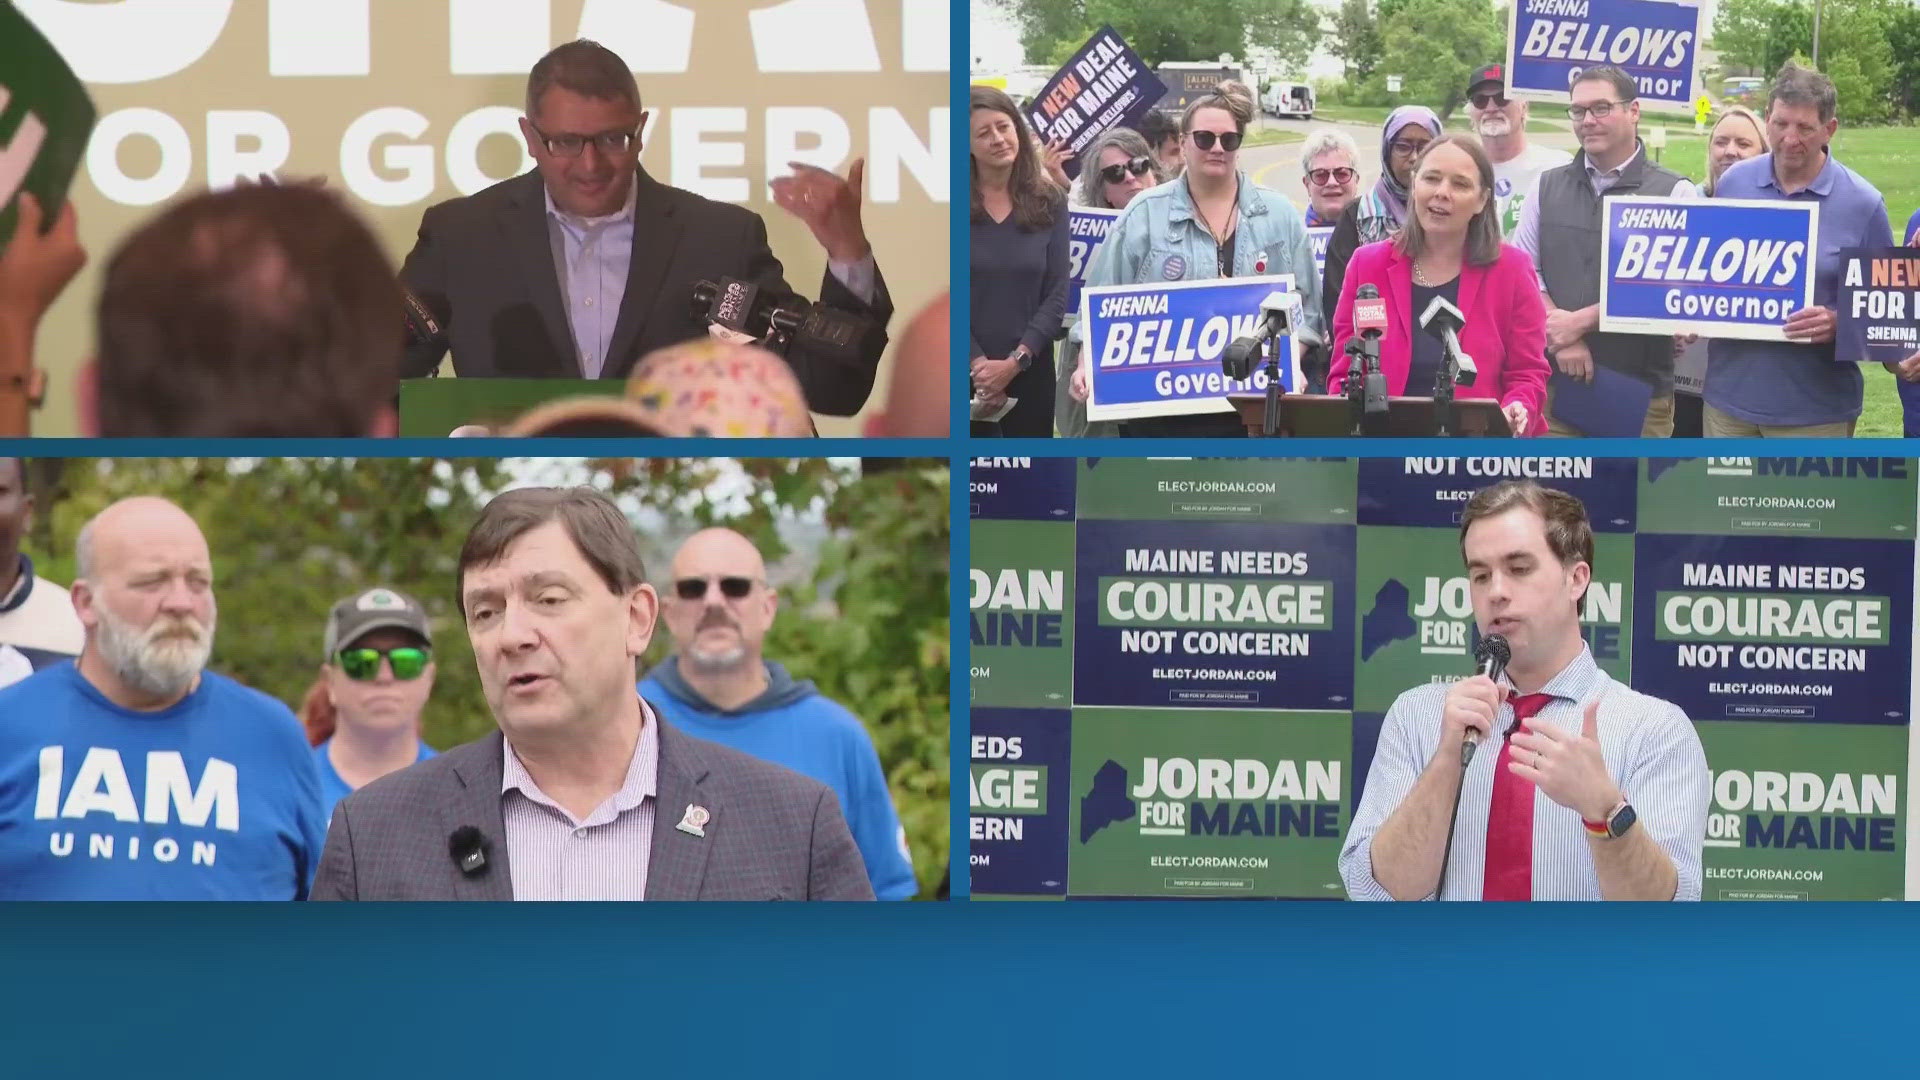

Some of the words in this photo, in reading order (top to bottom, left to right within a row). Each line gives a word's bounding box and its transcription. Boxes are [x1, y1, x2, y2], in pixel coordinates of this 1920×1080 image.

[1526, 0, 1589, 18] SHENNA
[1522, 19, 1693, 68] BELLOWS
[1033, 112, 1049, 134] A
[1042, 72, 1081, 119] NEW
[1076, 35, 1124, 83] DEAL
[1568, 66, 1683, 96] Gnor
[1047, 107, 1084, 140] FOR
[1075, 56, 1137, 117] MAINE
[87, 106, 291, 206] OR
[340, 105, 949, 206] GOERN
[1069, 217, 1115, 237] HENN
[1618, 208, 1688, 230] SHENNA
[1615, 234, 1805, 286] BELLOWS
[1845, 258, 1863, 287] A
[1099, 294, 1168, 319] SHENNA
[1665, 289, 1795, 320] Governor
[1852, 290, 1905, 319] FOR
[1100, 314, 1270, 367] BELLOW
[1866, 326, 1917, 341] SHENNA
[1404, 457, 1460, 475] NOT
[1466, 457, 1592, 478] CONCERN
[1157, 481, 1276, 493] ELECTJORDAN.COM
[1718, 496, 1836, 509] ELECTJORDAN.COM
[1126, 549, 1214, 573] MAINE
[1221, 550, 1308, 575] NEEDS
[1683, 563, 1772, 588] MAINE
[1778, 566, 1866, 590] NEEDS
[1107, 581, 1325, 624] COURAGE
[1664, 596, 1881, 639] COURAGE
[1121, 630, 1177, 654] NOT
[1183, 631, 1309, 656] CONCERN
[1421, 621, 1466, 646] FOR
[1678, 645, 1734, 668] NOT
[1739, 647, 1866, 672] CONCERN
[1152, 668, 1277, 681] ELECTJORDAN.COM
[1709, 682, 1833, 696] ELECTJORDAN.COM
[35, 745, 240, 831] IAM
[1133, 757, 1341, 801] JORDAN
[1140, 801, 1186, 826] FOR
[1190, 802, 1339, 837] MAINE
[1707, 813, 1741, 838] OR
[1746, 814, 1895, 852] MAINE
[50, 832, 216, 867] UNION
[1150, 856, 1269, 868] ELECTJORDAN.COM
[1705, 868, 1824, 881] ELECTJORDAN.COM
